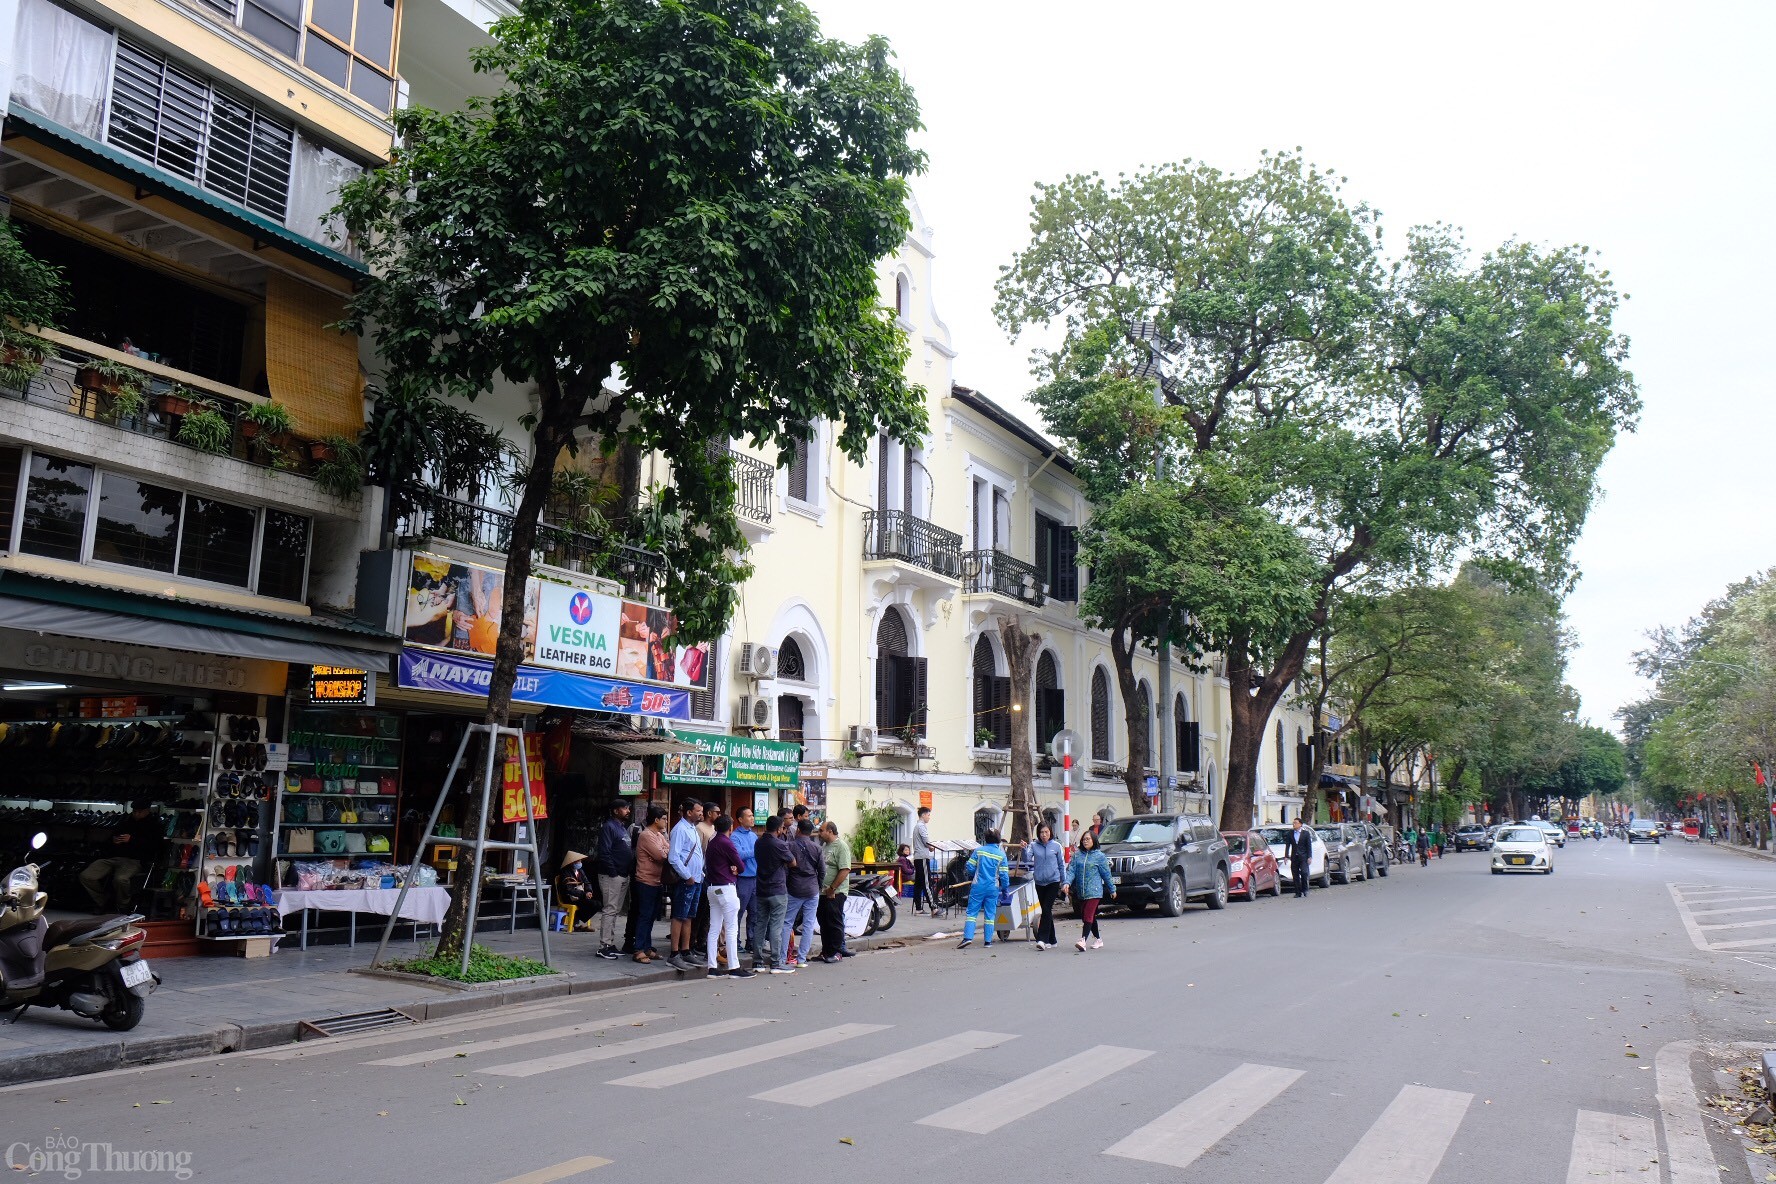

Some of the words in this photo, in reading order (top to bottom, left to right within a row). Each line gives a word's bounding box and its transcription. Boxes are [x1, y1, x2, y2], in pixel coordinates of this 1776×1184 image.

[550, 624, 607, 652] VESNA
[540, 647, 587, 666] LEATHER
[589, 655, 612, 669] BAG
[430, 663, 492, 687] MAY10
[315, 680, 362, 699] WORKSHOP
[506, 736, 542, 757] SALE
[713, 738, 727, 753] Hồ
[729, 743, 741, 758] Lake
[741, 744, 752, 759] View
[752, 745, 762, 760] Side
[762, 746, 785, 762] Restaurant
[315, 756, 360, 778] Vesna
[737, 771, 756, 781] Vietnamese
[766, 763, 784, 773] Vietnamese
